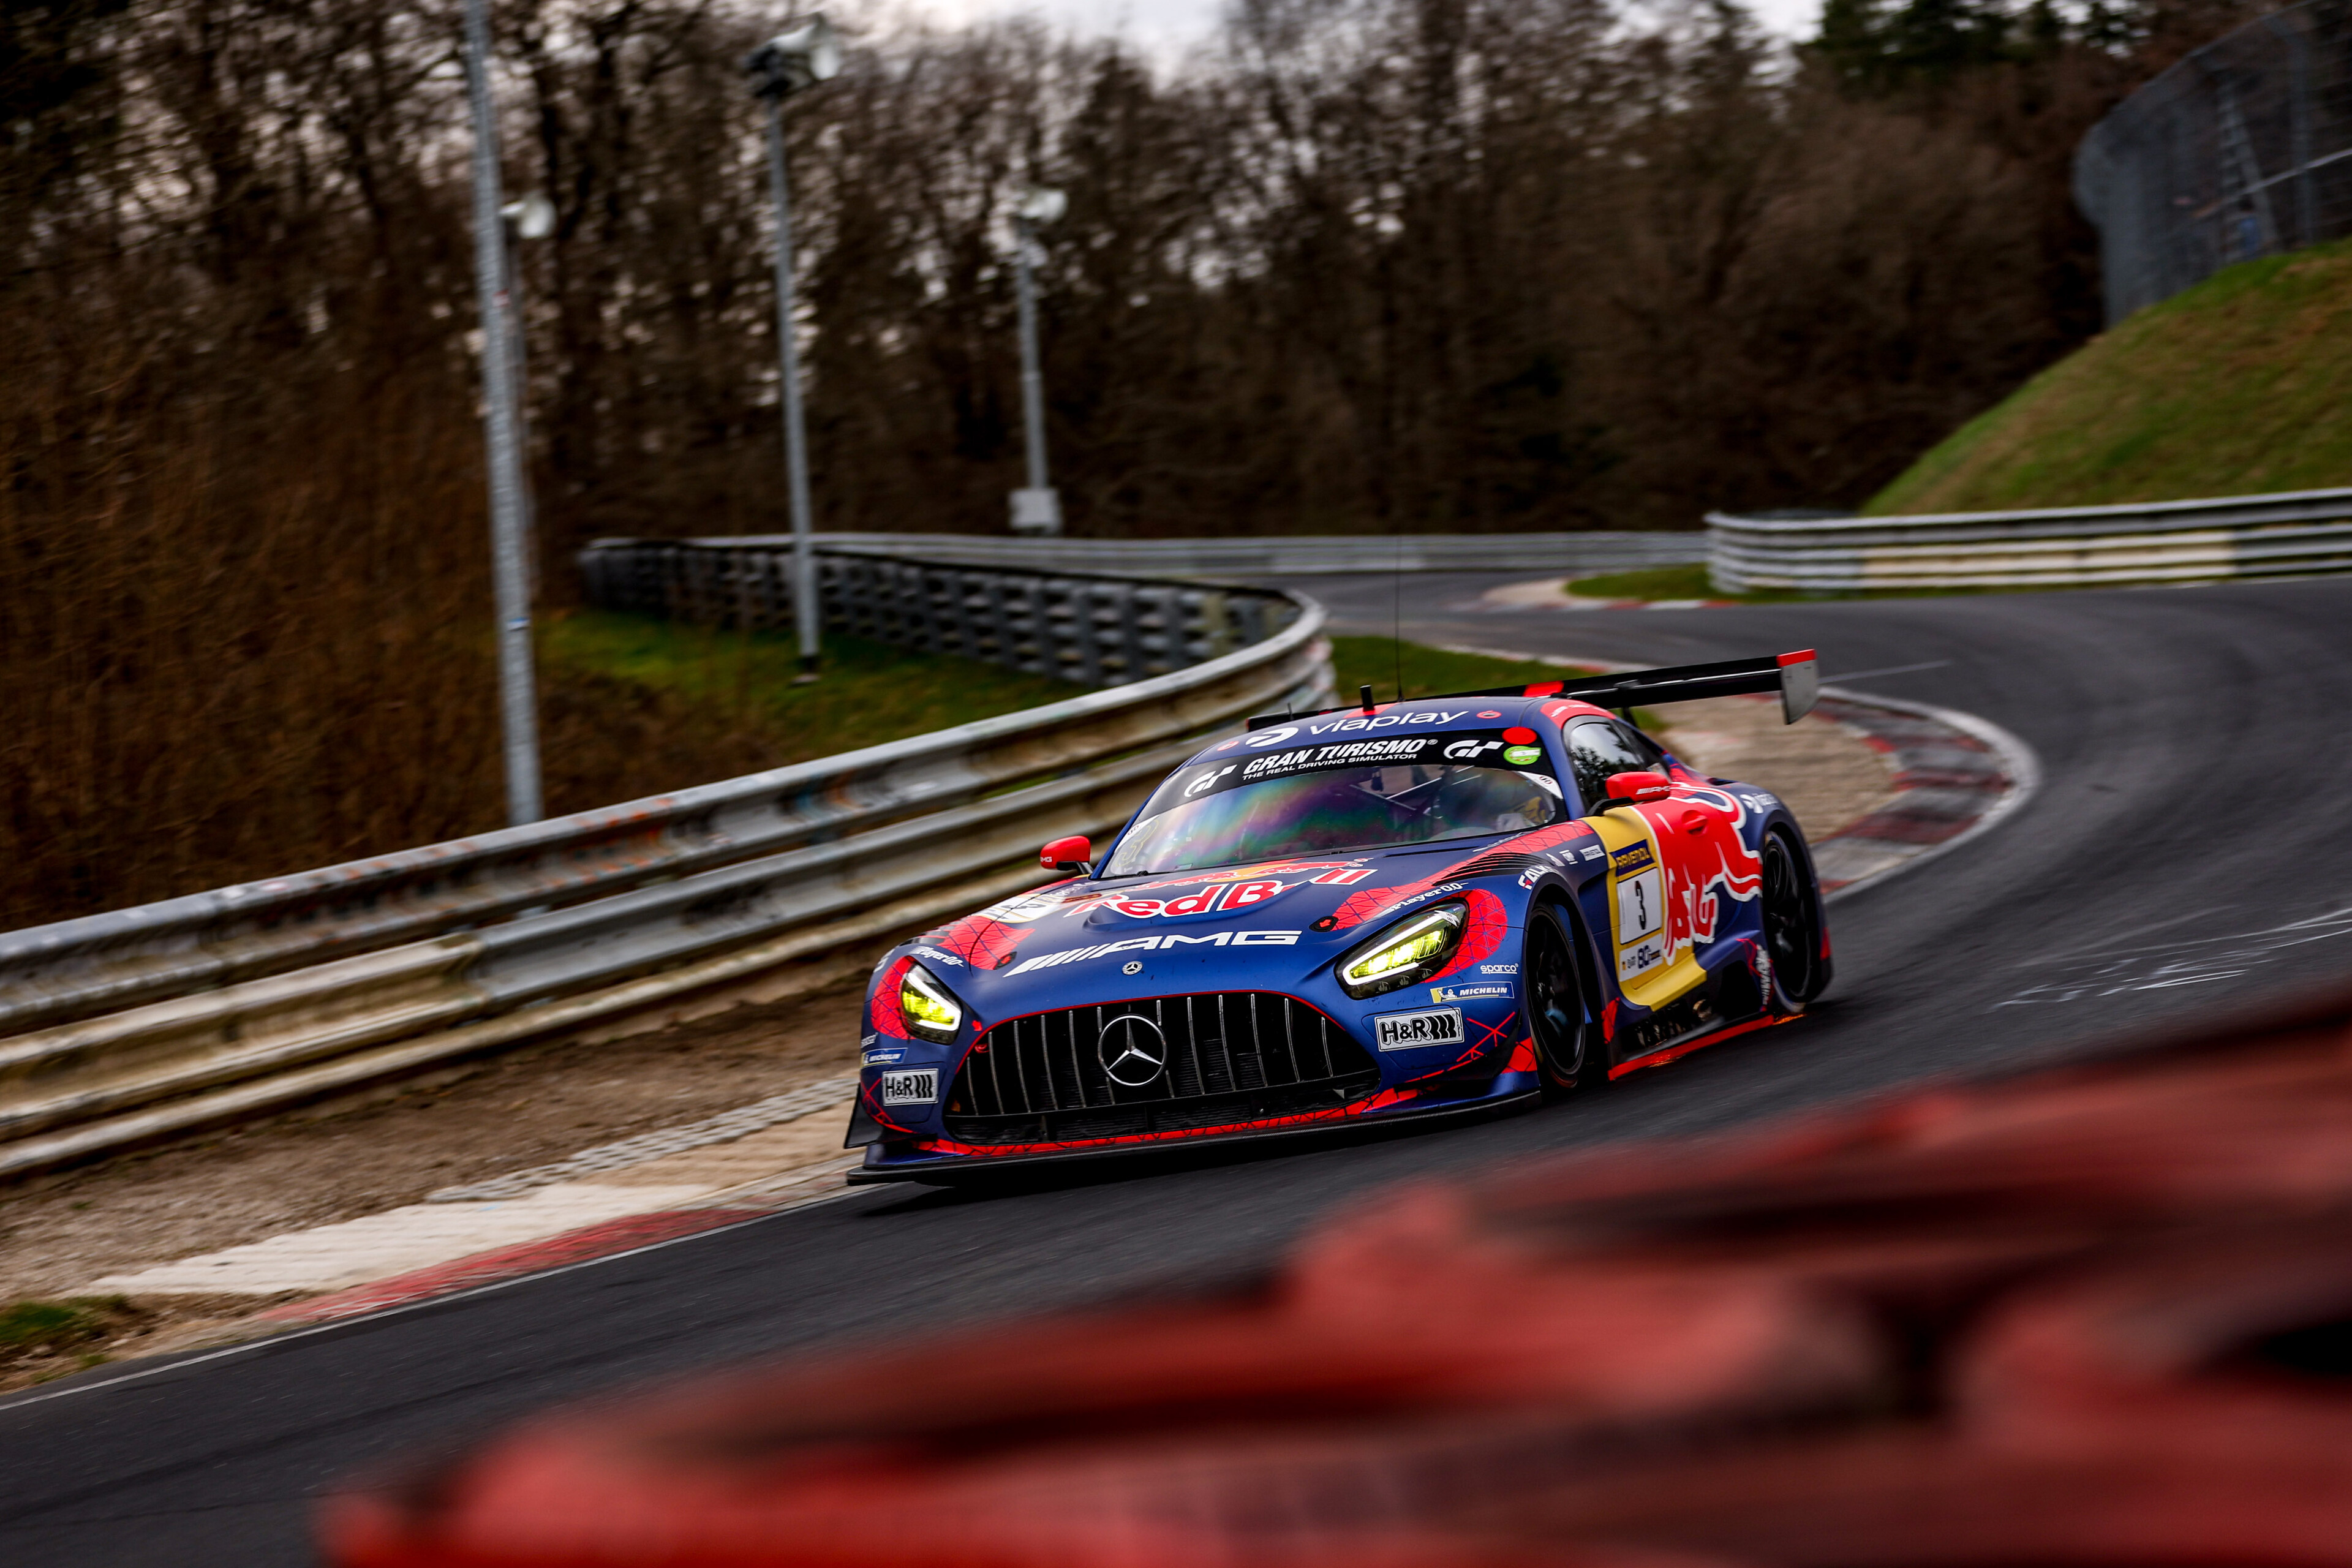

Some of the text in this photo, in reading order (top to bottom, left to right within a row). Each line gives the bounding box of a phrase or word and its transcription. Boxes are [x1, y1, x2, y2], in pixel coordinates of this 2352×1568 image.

[1310, 710, 1469, 736] viaplay
[1242, 753, 1417, 780] THE REAL DRIVING SIMULATOR
[1243, 748, 1315, 775] GRAN
[1216, 867, 1378, 911] Bll
[1634, 880, 1647, 930] 3
[1459, 987, 1508, 996] MICHELIN
[1379, 1018, 1431, 1045] H&R
[885, 1076, 913, 1098] H&R
